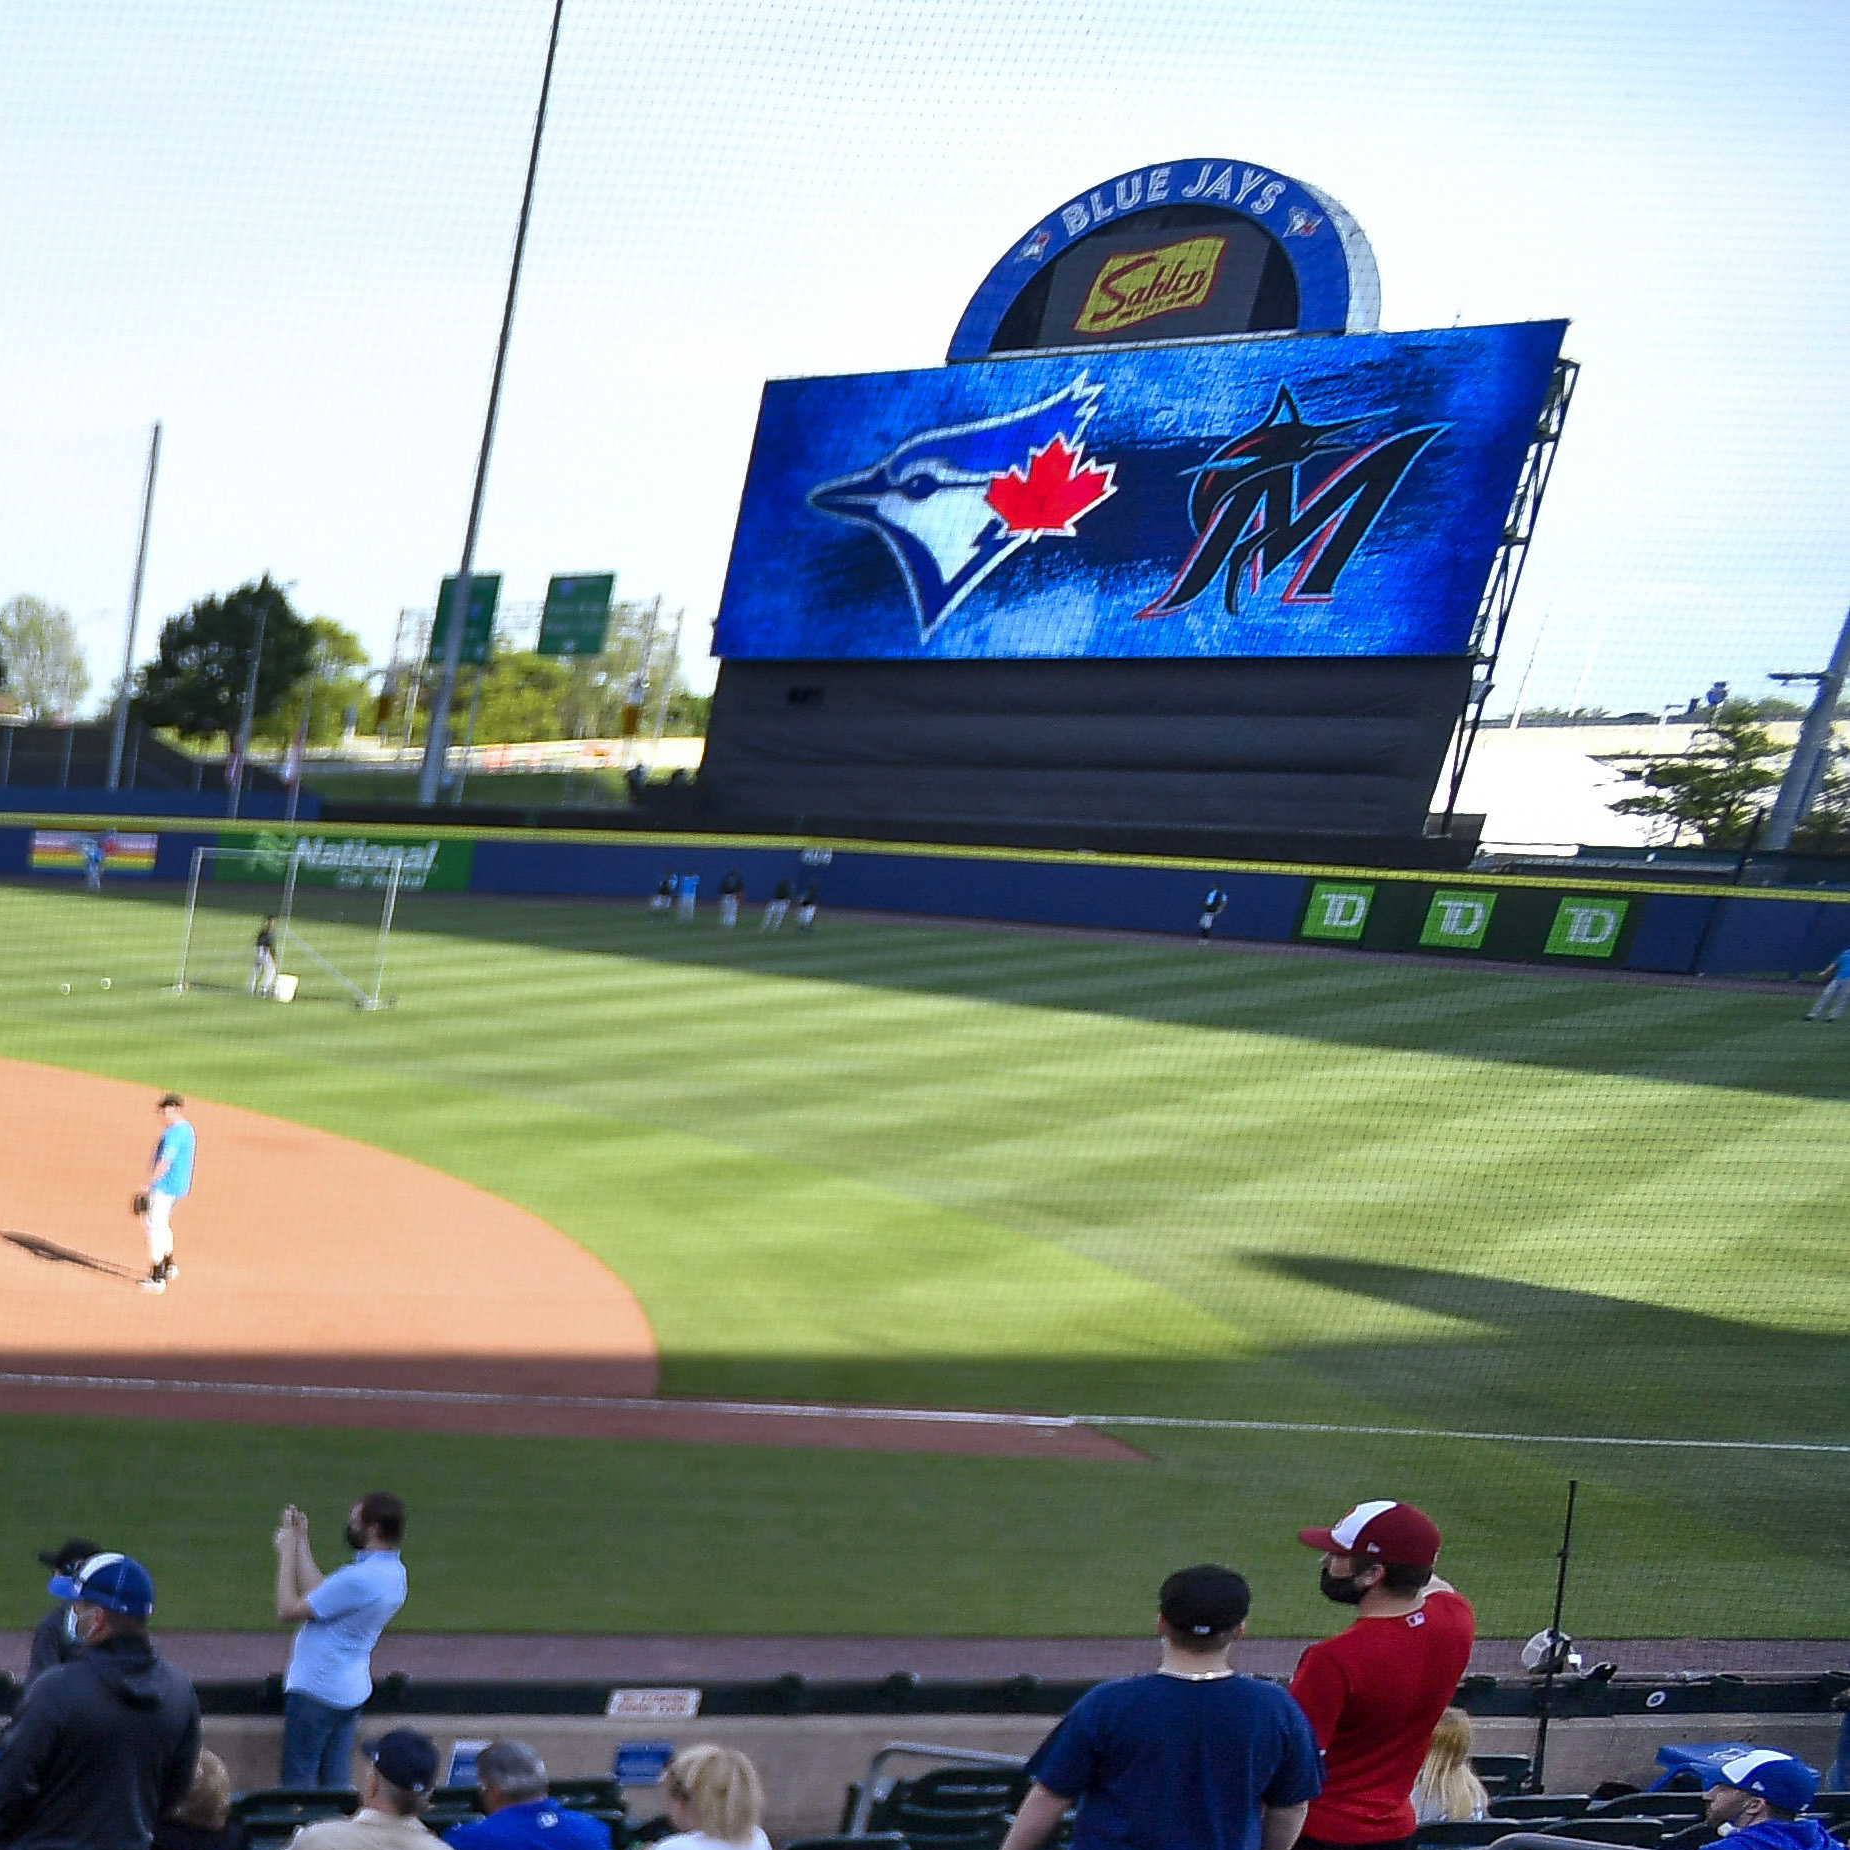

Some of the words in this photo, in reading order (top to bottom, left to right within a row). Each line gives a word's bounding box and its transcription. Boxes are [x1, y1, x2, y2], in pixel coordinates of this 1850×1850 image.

[1061, 165, 1172, 237] BLUE
[1181, 163, 1287, 216] JAYS
[1090, 256, 1209, 322] Sahlen
[1321, 892, 1367, 928] TD
[1437, 900, 1485, 936] TD
[1565, 907, 1618, 944] TD
